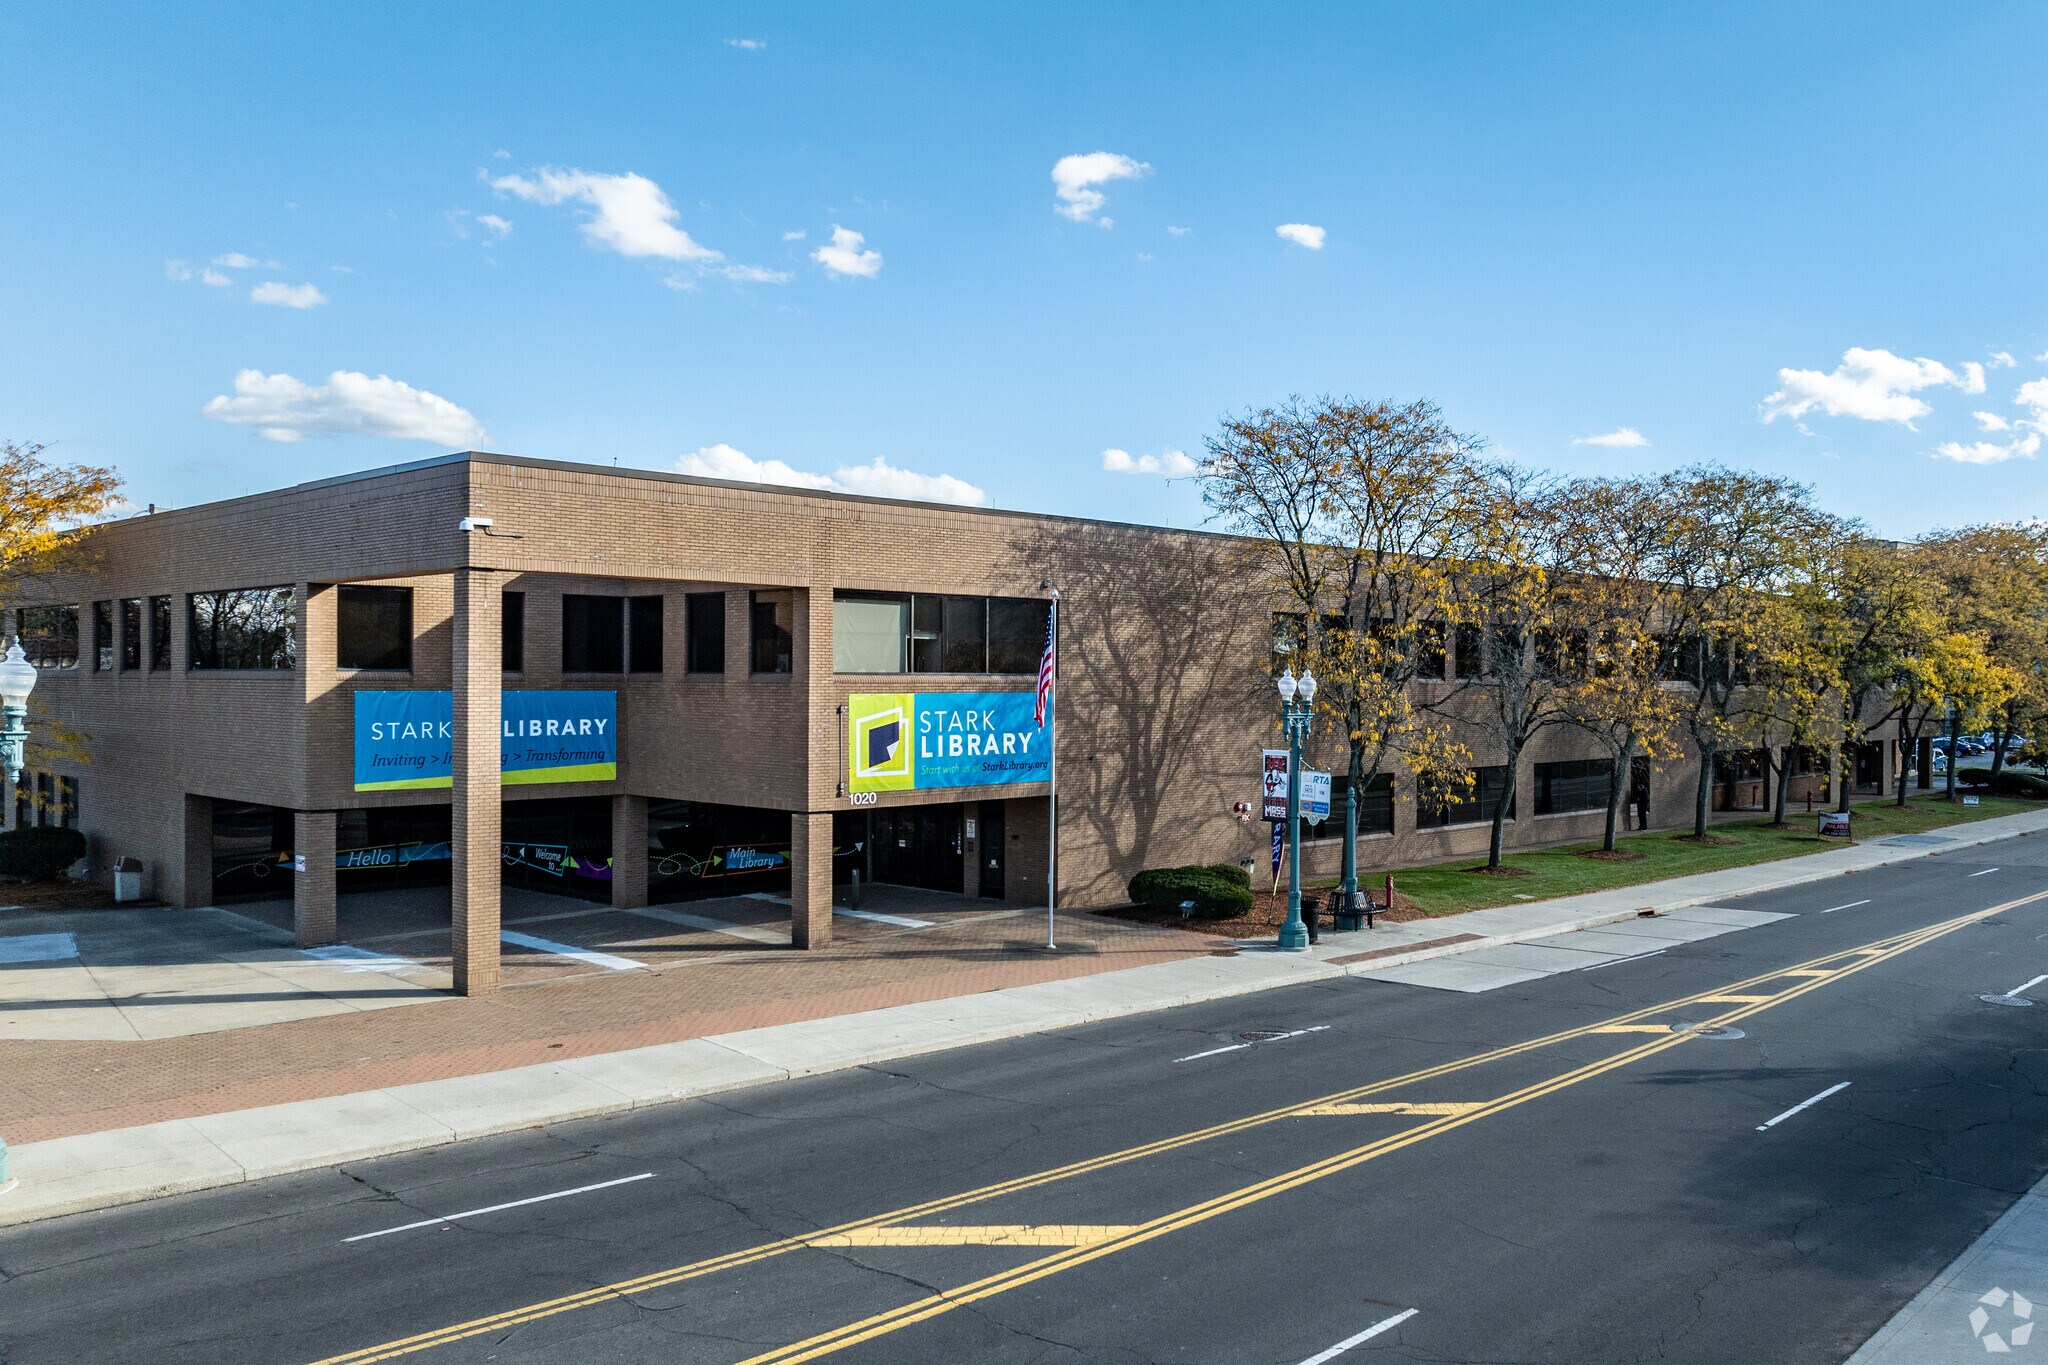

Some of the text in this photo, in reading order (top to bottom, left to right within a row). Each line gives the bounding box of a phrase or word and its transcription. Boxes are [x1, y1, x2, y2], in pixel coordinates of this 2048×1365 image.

[920, 710, 995, 733] STARK
[371, 718, 608, 741] STARK LIBRARY
[921, 732, 1033, 758] LIBRARY
[371, 753, 427, 769] Inviting
[525, 748, 606, 763] Transforming
[921, 765, 940, 775] Start
[942, 763, 960, 774] with
[982, 760, 1048, 771] StarkLibrary.org
[849, 792, 877, 805] 1020
[347, 849, 391, 867] Hello
[535, 847, 562, 861] Welcome
[730, 846, 756, 859] Main
[548, 861, 555, 870] to
[739, 857, 775, 868] Library
